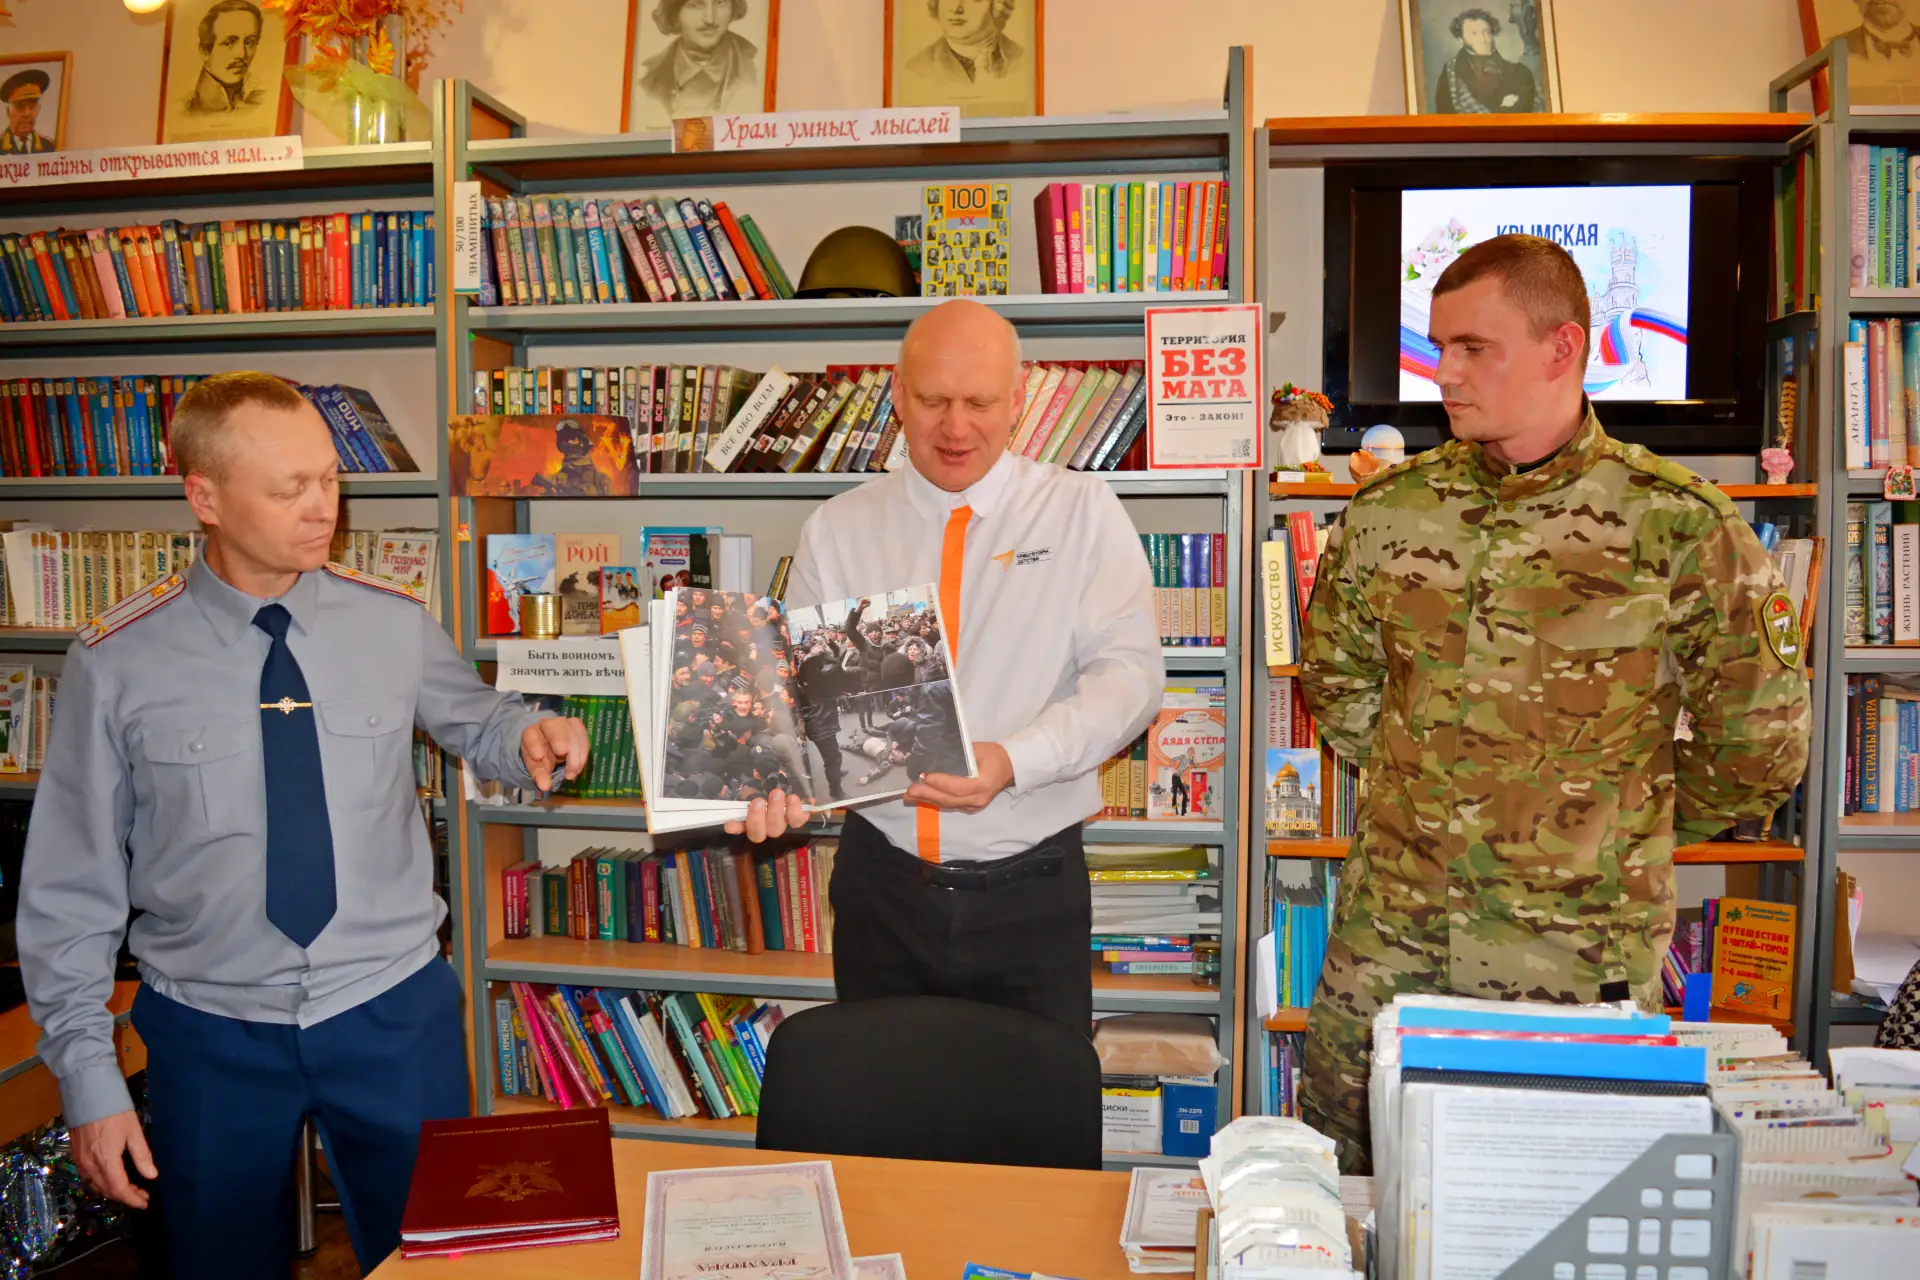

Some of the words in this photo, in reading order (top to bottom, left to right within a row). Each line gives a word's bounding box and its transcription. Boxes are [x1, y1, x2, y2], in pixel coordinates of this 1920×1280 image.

[720, 117, 777, 148] Храм
[785, 117, 861, 147] умных
[869, 112, 951, 136] мыслей
[37, 157, 93, 177] тайны
[99, 147, 221, 178] открываются
[949, 187, 986, 210] 100
[455, 216, 466, 233] 100
[1868, 196, 1877, 246] ВЕЛИКИХ
[469, 192, 479, 277] ЗНАМЕНИТЫХ
[455, 241, 466, 253] 50
[646, 233, 669, 276] ТИРАНОВ
[695, 231, 721, 274] ЖЕНЩИН
[1160, 334, 1246, 346] ТЕРРИТОРИЯ
[1160, 347, 1247, 378] БЕЗ
[1161, 379, 1248, 400] МАТА
[640, 404, 649, 423] ВСЕ
[655, 403, 664, 422] ВСЕ
[682, 401, 693, 421] ВСЕ
[719, 435, 737, 457] ВСЕ
[735, 411, 753, 436] ОБО
[752, 382, 776, 412] ВСЕМ
[774, 409, 790, 429] ВСЕ
[792, 409, 809, 430] ВСЕ
[1165, 413, 1187, 422] Это
[1199, 412, 1244, 421] ЗАКОН!
[1849, 380, 1860, 444] АВАНТА
[391, 555, 426, 567] ПОЗНАЮ
[567, 542, 609, 563] РОЙ
[648, 547, 690, 557] РАССКАЗ
[1901, 532, 1911, 589] РАСТЕНИЙ
[393, 564, 412, 574] МИР
[564, 610, 600, 621] ДОНБАС
[1214, 593, 1223, 621] ЧЕХОВ
[1268, 559, 1284, 653] ИСКУССТВО
[1902, 594, 1911, 633] ЖИЗНЬ
[1774, 616, 1796, 655] Z
[527, 649, 559, 661] Быть
[561, 652, 615, 661] воиномъ
[562, 668, 593, 677] жить
[595, 666, 626, 677] вѣчн
[1865, 698, 1877, 730] МИРА
[1161, 736, 1191, 746] ДЯДЯ
[1193, 735, 1225, 745] СТЁПА
[1865, 734, 1877, 781] СТРАНЫ
[1865, 783, 1877, 805] ВСЕ
[1899, 761, 1908, 807] ГЕОГРАФИЯ
[1722, 925, 1790, 943] ПУТЕШЕСТВИЕ
[1729, 938, 1789, 956] ЧИТАЙ-ГОРОД
[501, 1018, 511, 1051] ИМЕНИ
[1101, 1104, 1128, 1112] ДИСКИ
[693, 1258, 799, 1273] ГРАМОТА
